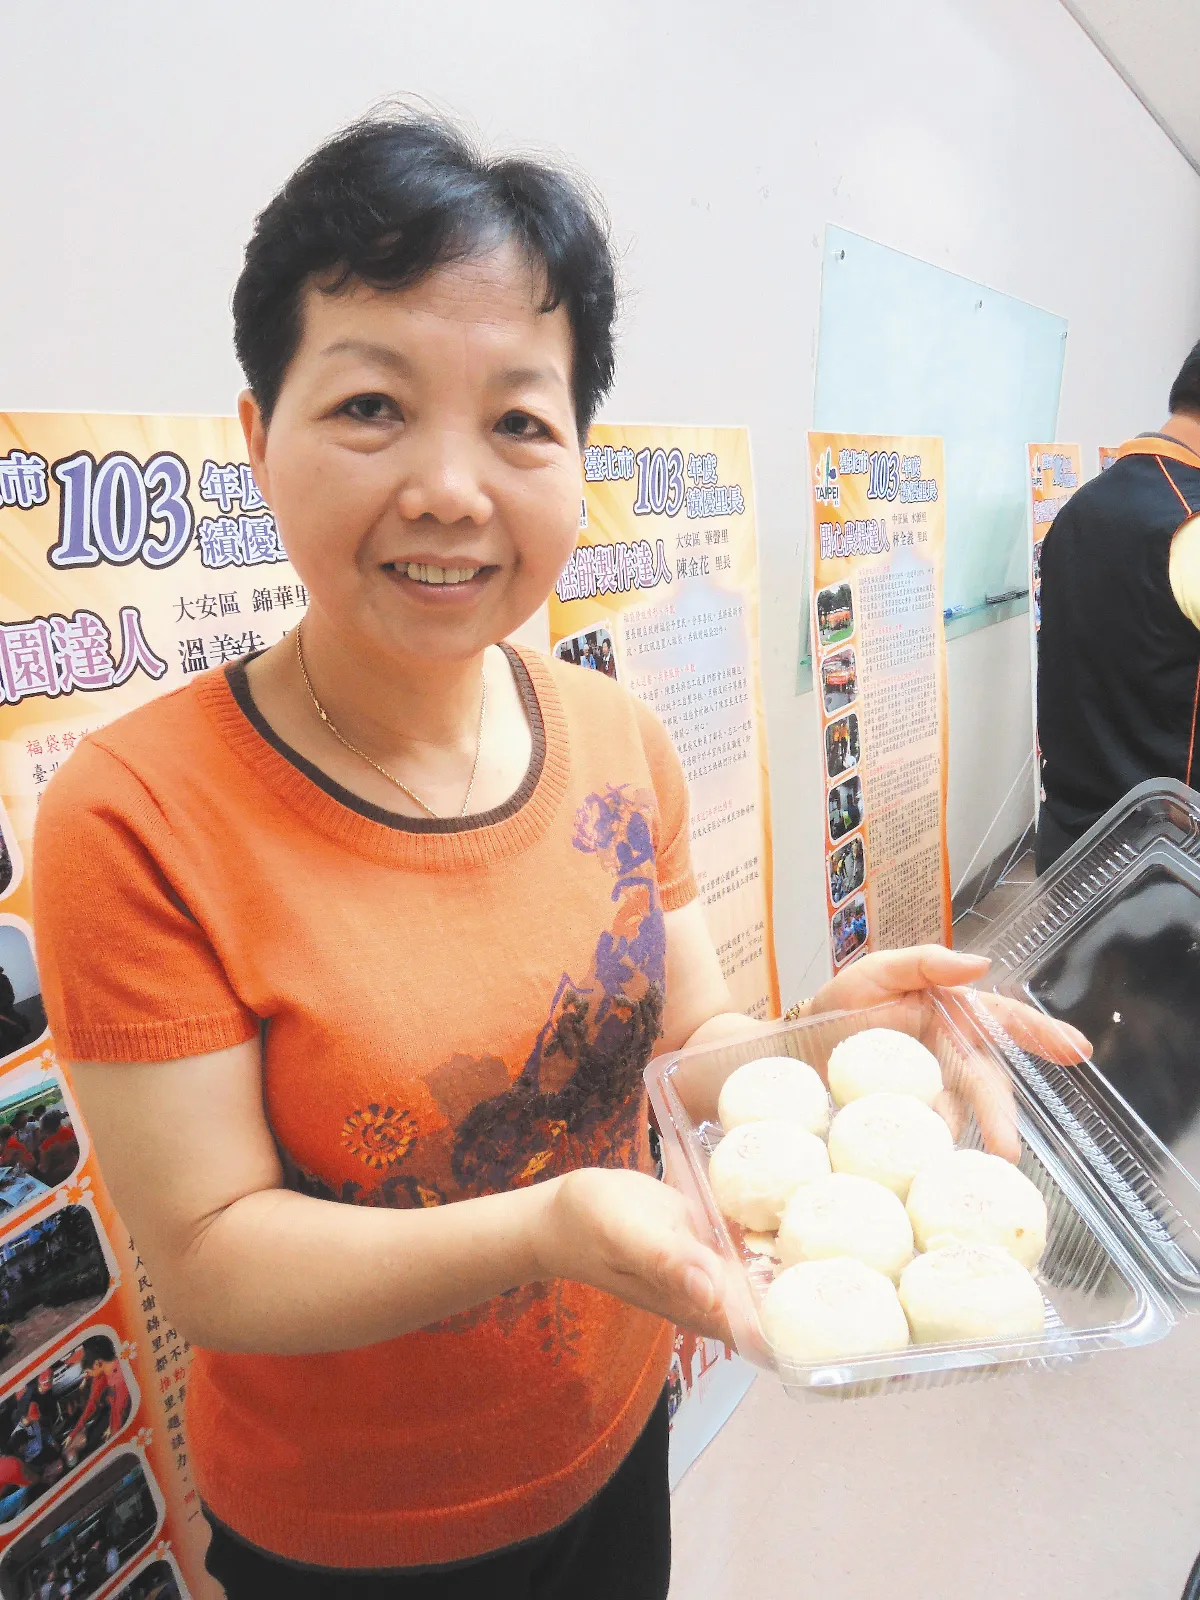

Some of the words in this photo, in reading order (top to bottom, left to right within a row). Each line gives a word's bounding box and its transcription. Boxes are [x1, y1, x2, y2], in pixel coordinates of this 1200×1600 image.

[634, 447, 685, 518] 103
[687, 453, 718, 485] 年度
[867, 451, 900, 503] 103
[48, 450, 195, 570] 103
[675, 531, 702, 550] 大安區
[676, 554, 710, 580] 陳金花
[173, 590, 241, 624] 大安區
